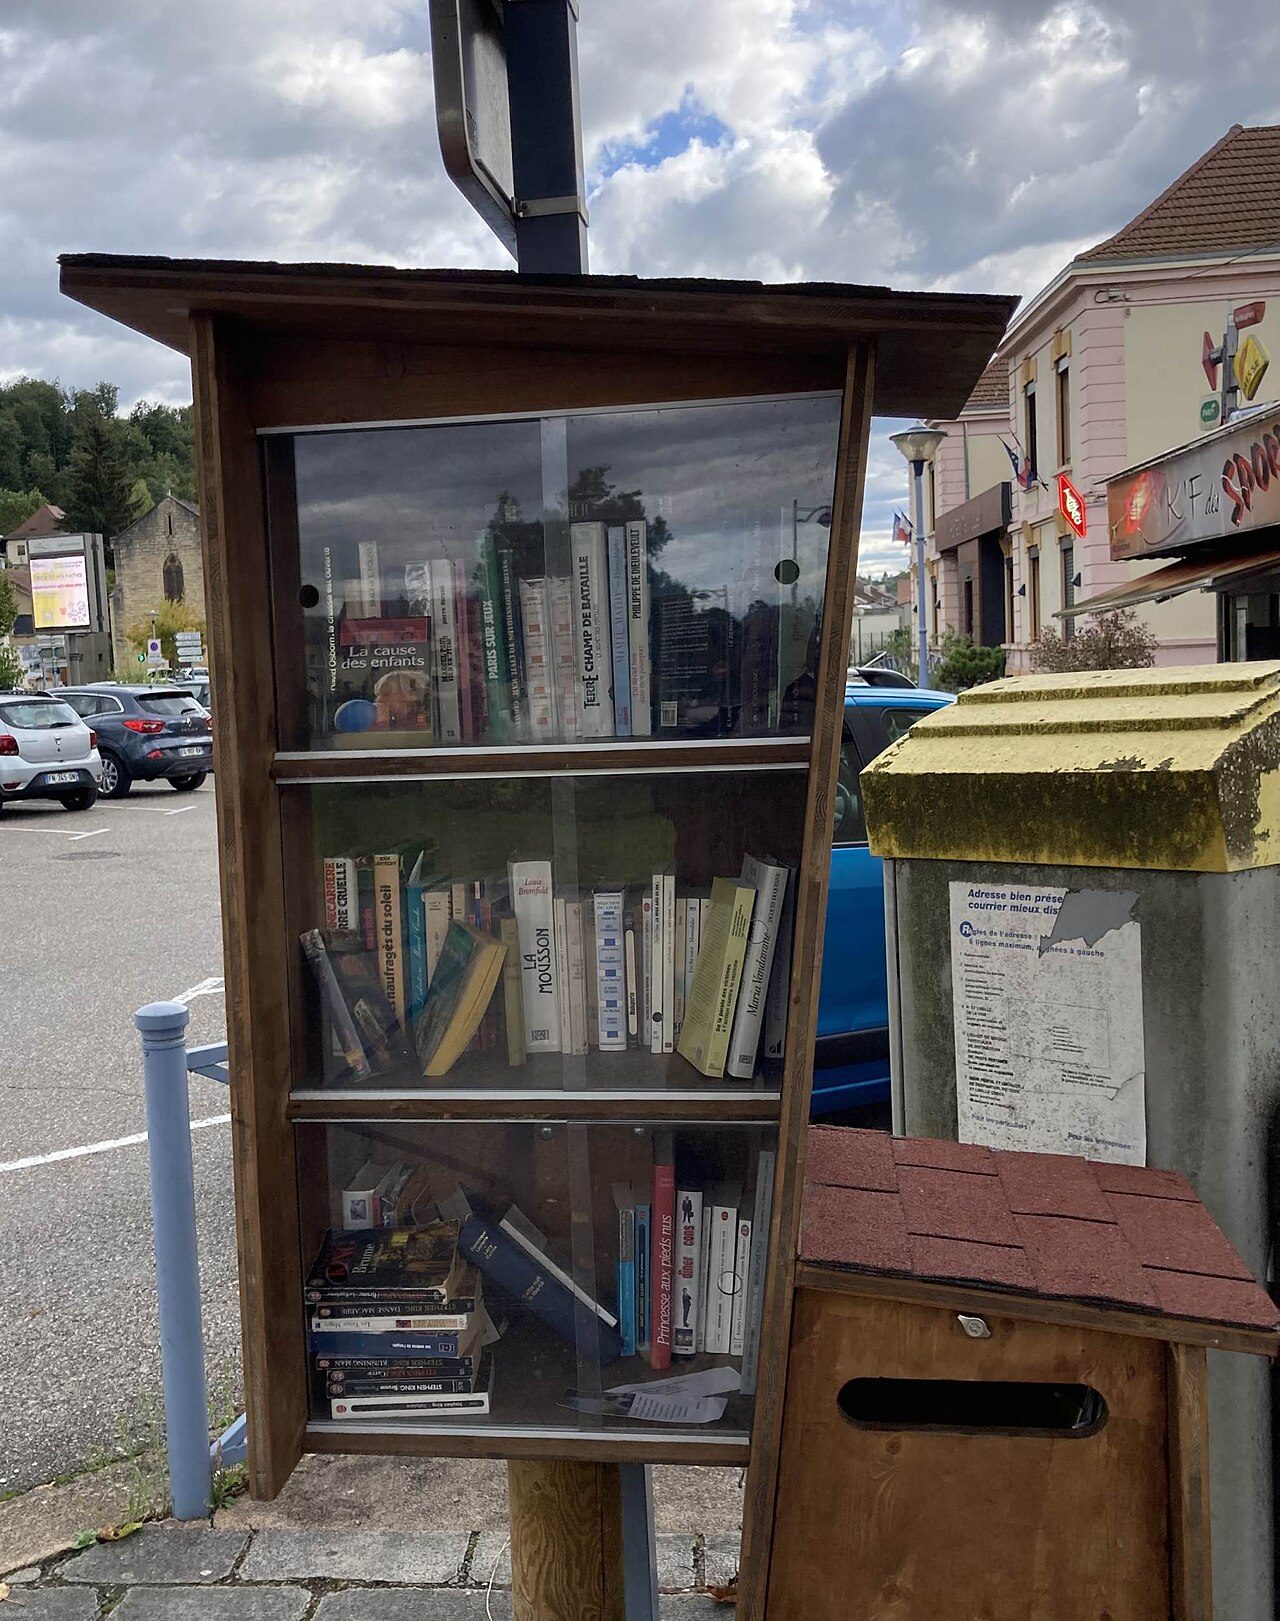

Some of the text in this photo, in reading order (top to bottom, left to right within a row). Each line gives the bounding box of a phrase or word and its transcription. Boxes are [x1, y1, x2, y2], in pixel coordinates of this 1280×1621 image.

[1221, 423, 1280, 528] SPOR
[578, 556, 591, 610] BATAILLE
[628, 528, 642, 619] PHILIPPE DE DIEULEVEULT
[582, 612, 592, 628] DE
[482, 600, 499, 680] PARIS SUR JEUX
[349, 645, 416, 658] La cause
[582, 630, 594, 672] CHAMP
[341, 656, 425, 670] des enfants
[336, 862, 348, 907] CRUELLE
[380, 884, 392, 918] soleil
[968, 889, 1006, 900] Adresse
[1010, 892, 1031, 902] bien
[968, 902, 1007, 912] courrier
[1010, 904, 1040, 913] mieux
[382, 920, 393, 936] du
[1000, 930, 1034, 940] l'adresse
[976, 938, 996, 948] lignes
[998, 941, 1035, 951] maximum,
[1070, 946, 1074, 954] à
[1076, 948, 1105, 958] gauche
[384, 938, 396, 999] naufragés
[524, 953, 536, 970] LA
[536, 928, 552, 994] MOUSSON
[746, 933, 771, 1017] Maria Vandamme
[1068, 1132, 1082, 1140] Pour
[681, 1226, 694, 1246] cons
[656, 1214, 674, 1346] Princesse aux pieds nus
[424, 1304, 455, 1312] STEPHEN
[352, 1359, 388, 1367] RUNNING
